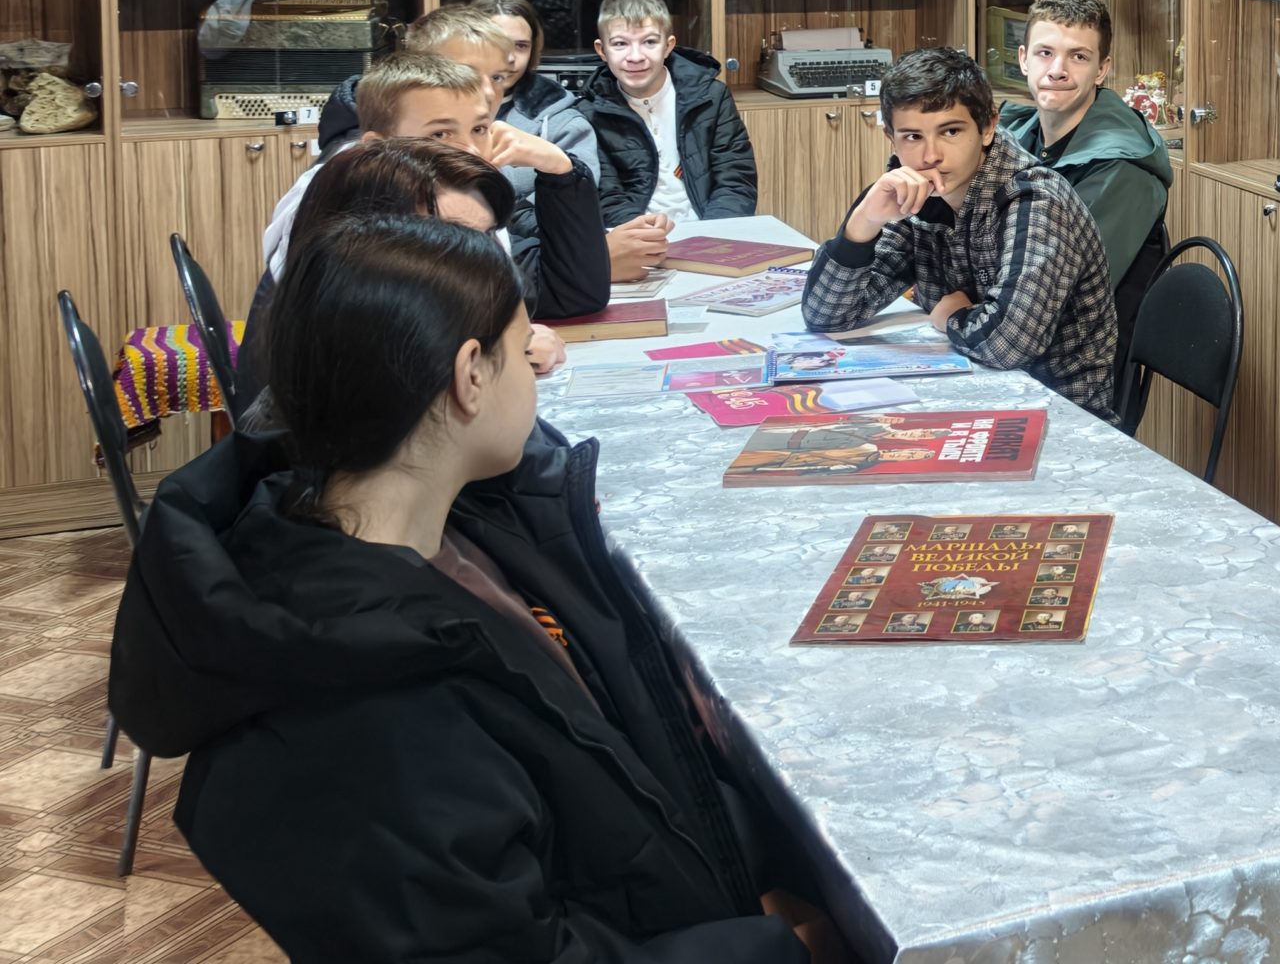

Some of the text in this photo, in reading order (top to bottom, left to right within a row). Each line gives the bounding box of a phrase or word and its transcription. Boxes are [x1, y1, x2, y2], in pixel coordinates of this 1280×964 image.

[870, 82, 877, 91] 5
[305, 109, 312, 119] 7
[960, 418, 995, 463] НА ФРОНТЕ
[985, 417, 1029, 461] ПЛАКАТ
[937, 437, 967, 461] ТЫЛУ
[904, 541, 1043, 551] МАРШАЛЫ
[909, 549, 1030, 562] ВЕЛИКОЙ
[911, 562, 1020, 572] ПОБЕДЫ
[917, 600, 986, 608] 1941-1945
